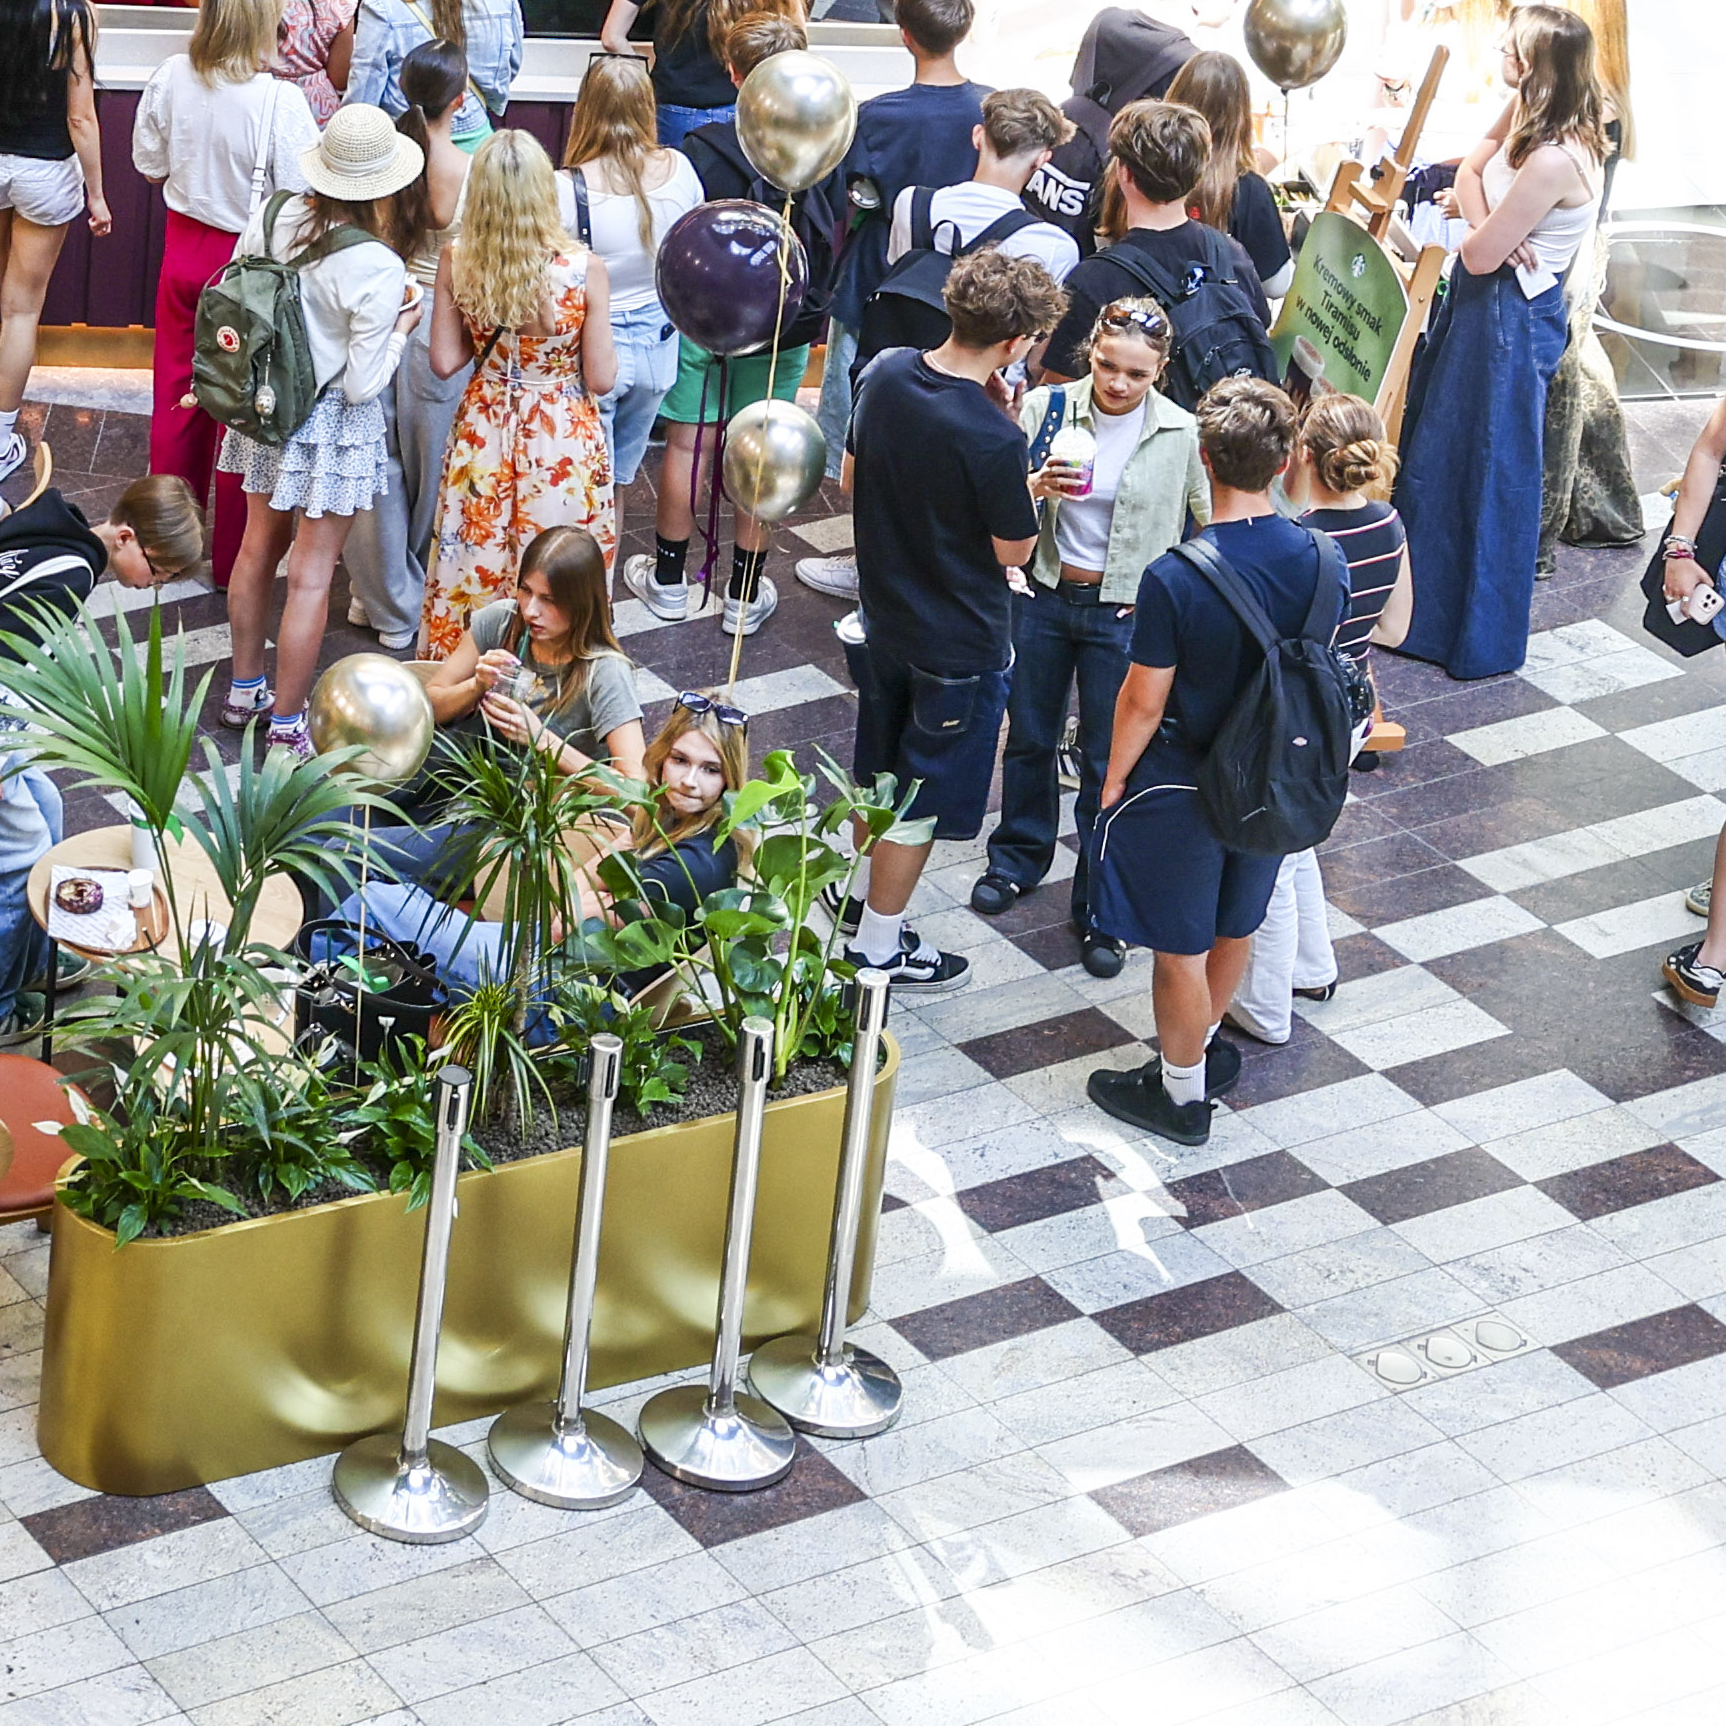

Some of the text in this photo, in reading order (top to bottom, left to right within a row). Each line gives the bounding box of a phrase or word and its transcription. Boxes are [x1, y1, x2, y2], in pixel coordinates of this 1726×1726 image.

[1026, 164, 1088, 216] ANS
[1313, 254, 1383, 338] Kremowy smak
[1320, 290, 1360, 341] Tiramisu
[1296, 295, 1371, 382] w nowej odsłonie
